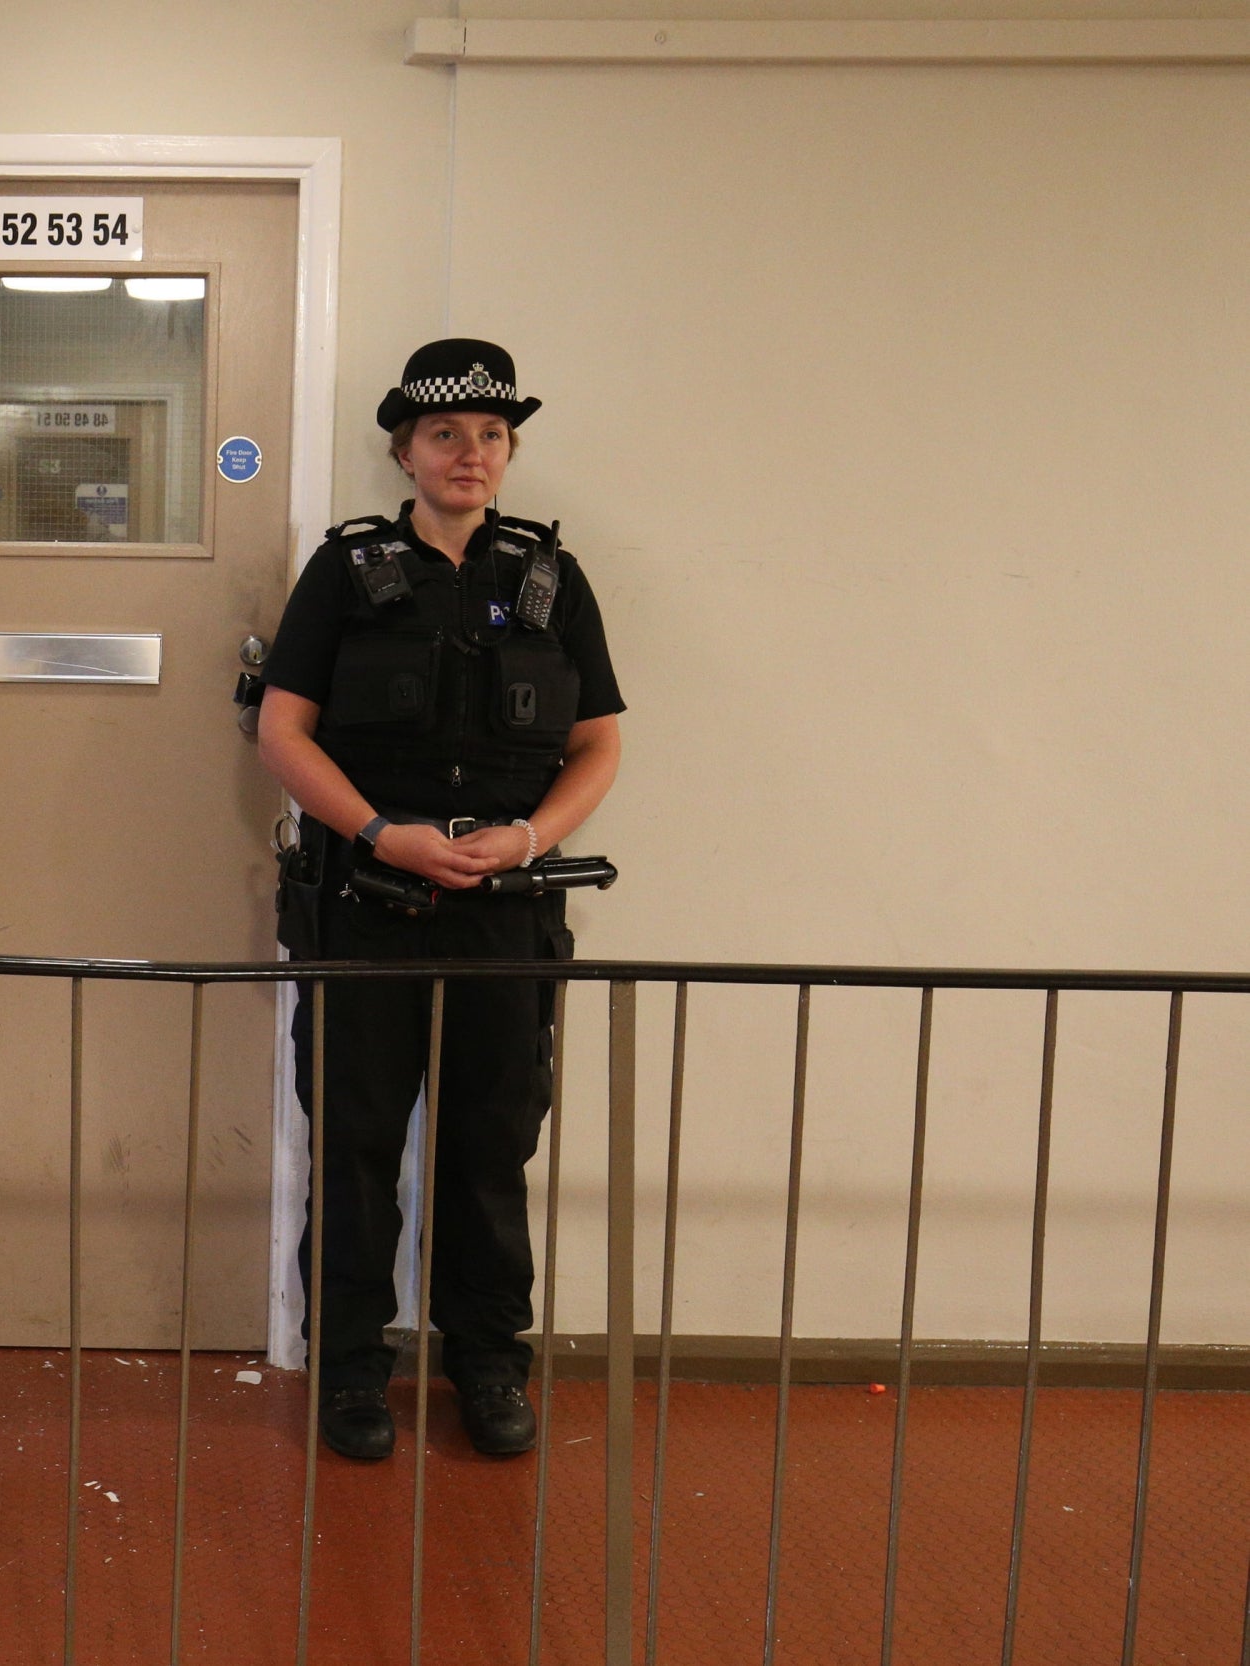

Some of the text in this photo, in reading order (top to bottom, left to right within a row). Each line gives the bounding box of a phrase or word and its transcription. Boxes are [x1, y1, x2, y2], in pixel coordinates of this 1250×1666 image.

[2, 213, 129, 246] 52 53 54
